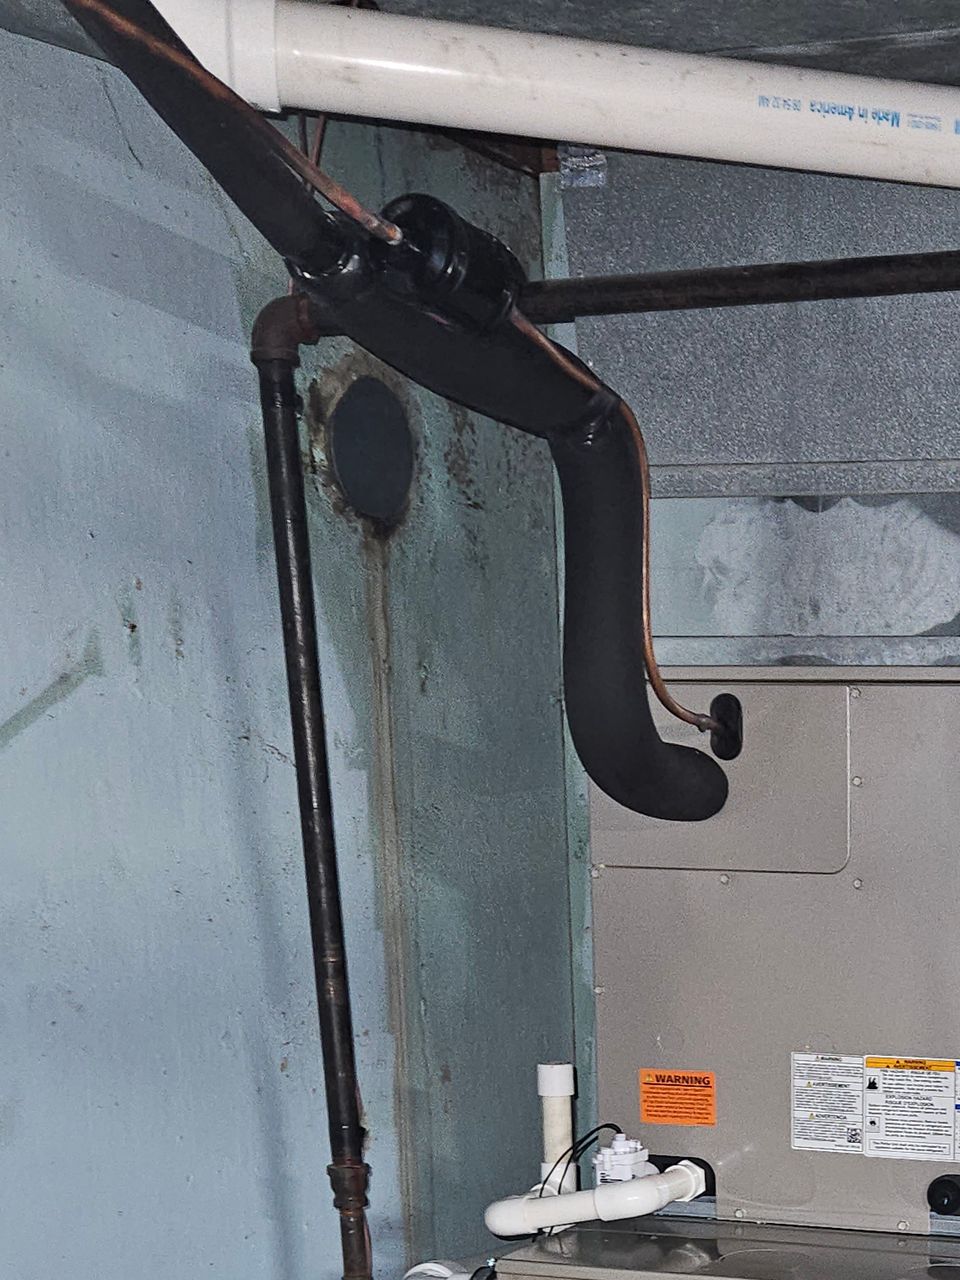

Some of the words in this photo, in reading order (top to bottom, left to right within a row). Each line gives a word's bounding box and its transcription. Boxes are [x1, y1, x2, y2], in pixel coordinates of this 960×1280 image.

[808, 99, 855, 121] America
[858, 104, 869, 124] in
[871, 107, 901, 128] Made
[655, 1074, 711, 1086] WARNING
